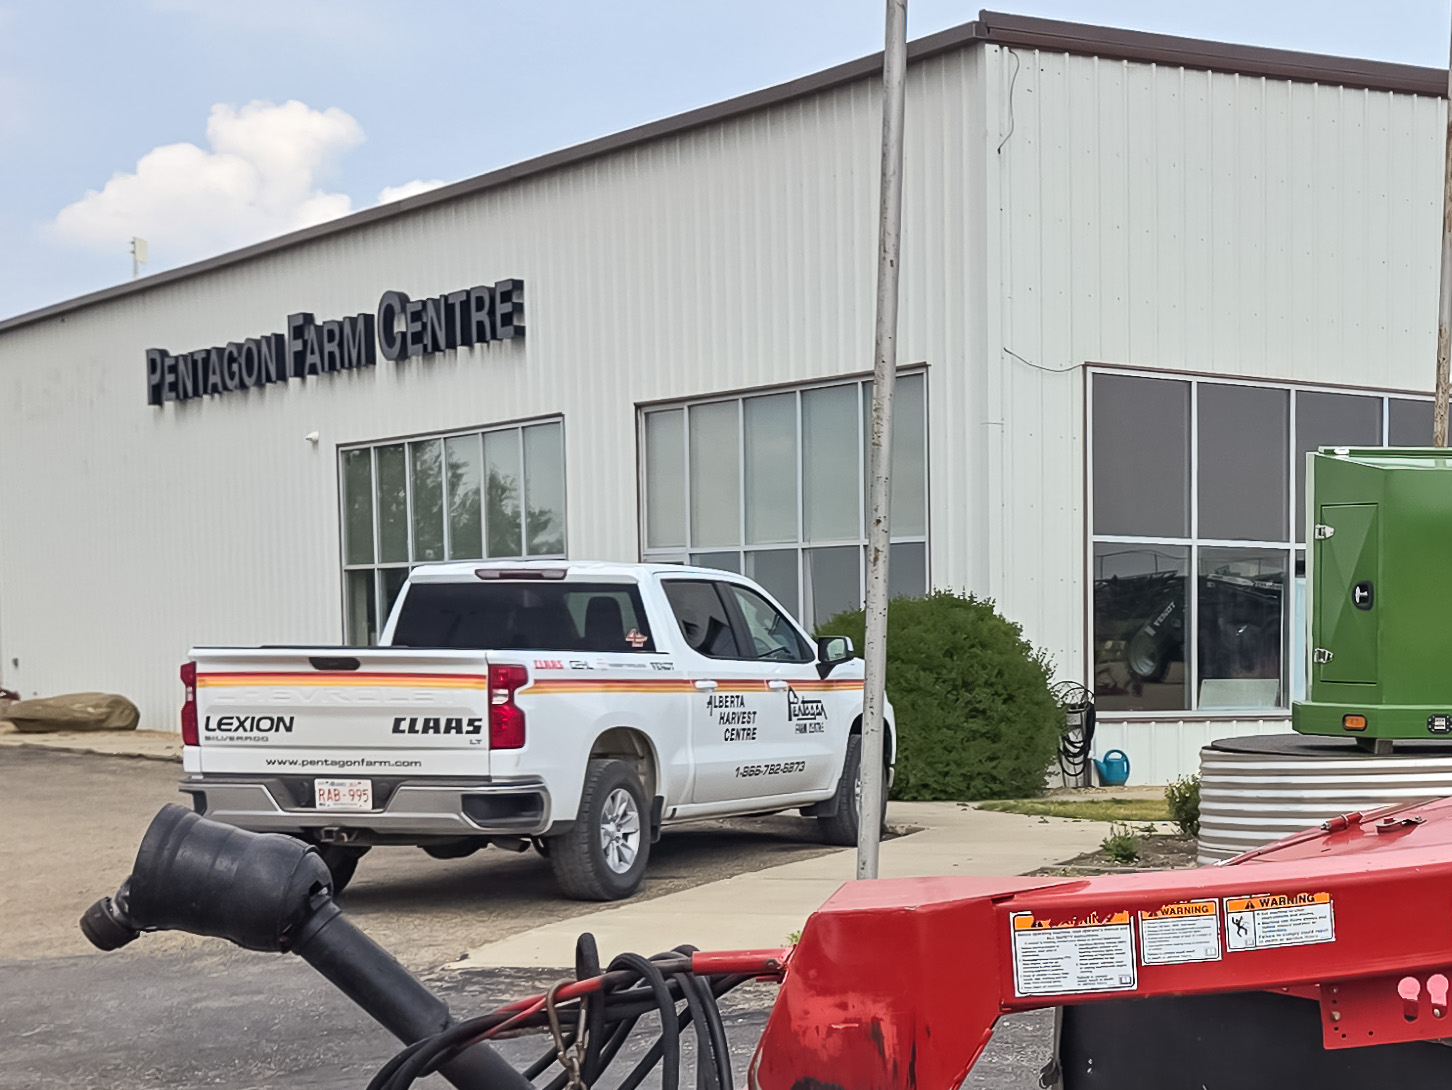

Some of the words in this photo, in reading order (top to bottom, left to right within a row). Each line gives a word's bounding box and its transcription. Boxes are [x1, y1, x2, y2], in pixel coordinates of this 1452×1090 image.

[146, 332, 286, 406] PENTAGON
[287, 311, 377, 378] FARM
[377, 278, 526, 362] CENTRE
[706, 694, 746, 716] ALBERTA
[204, 715, 295, 733] LEXION
[718, 711, 757, 725] HARVEST
[391, 717, 483, 735] CLAAS
[724, 727, 757, 742] CENTRE
[265, 757, 423, 769] www.pentagonfarm.com
[319, 788, 369, 802] RAB-995
[1160, 904, 1209, 916] WARNING
